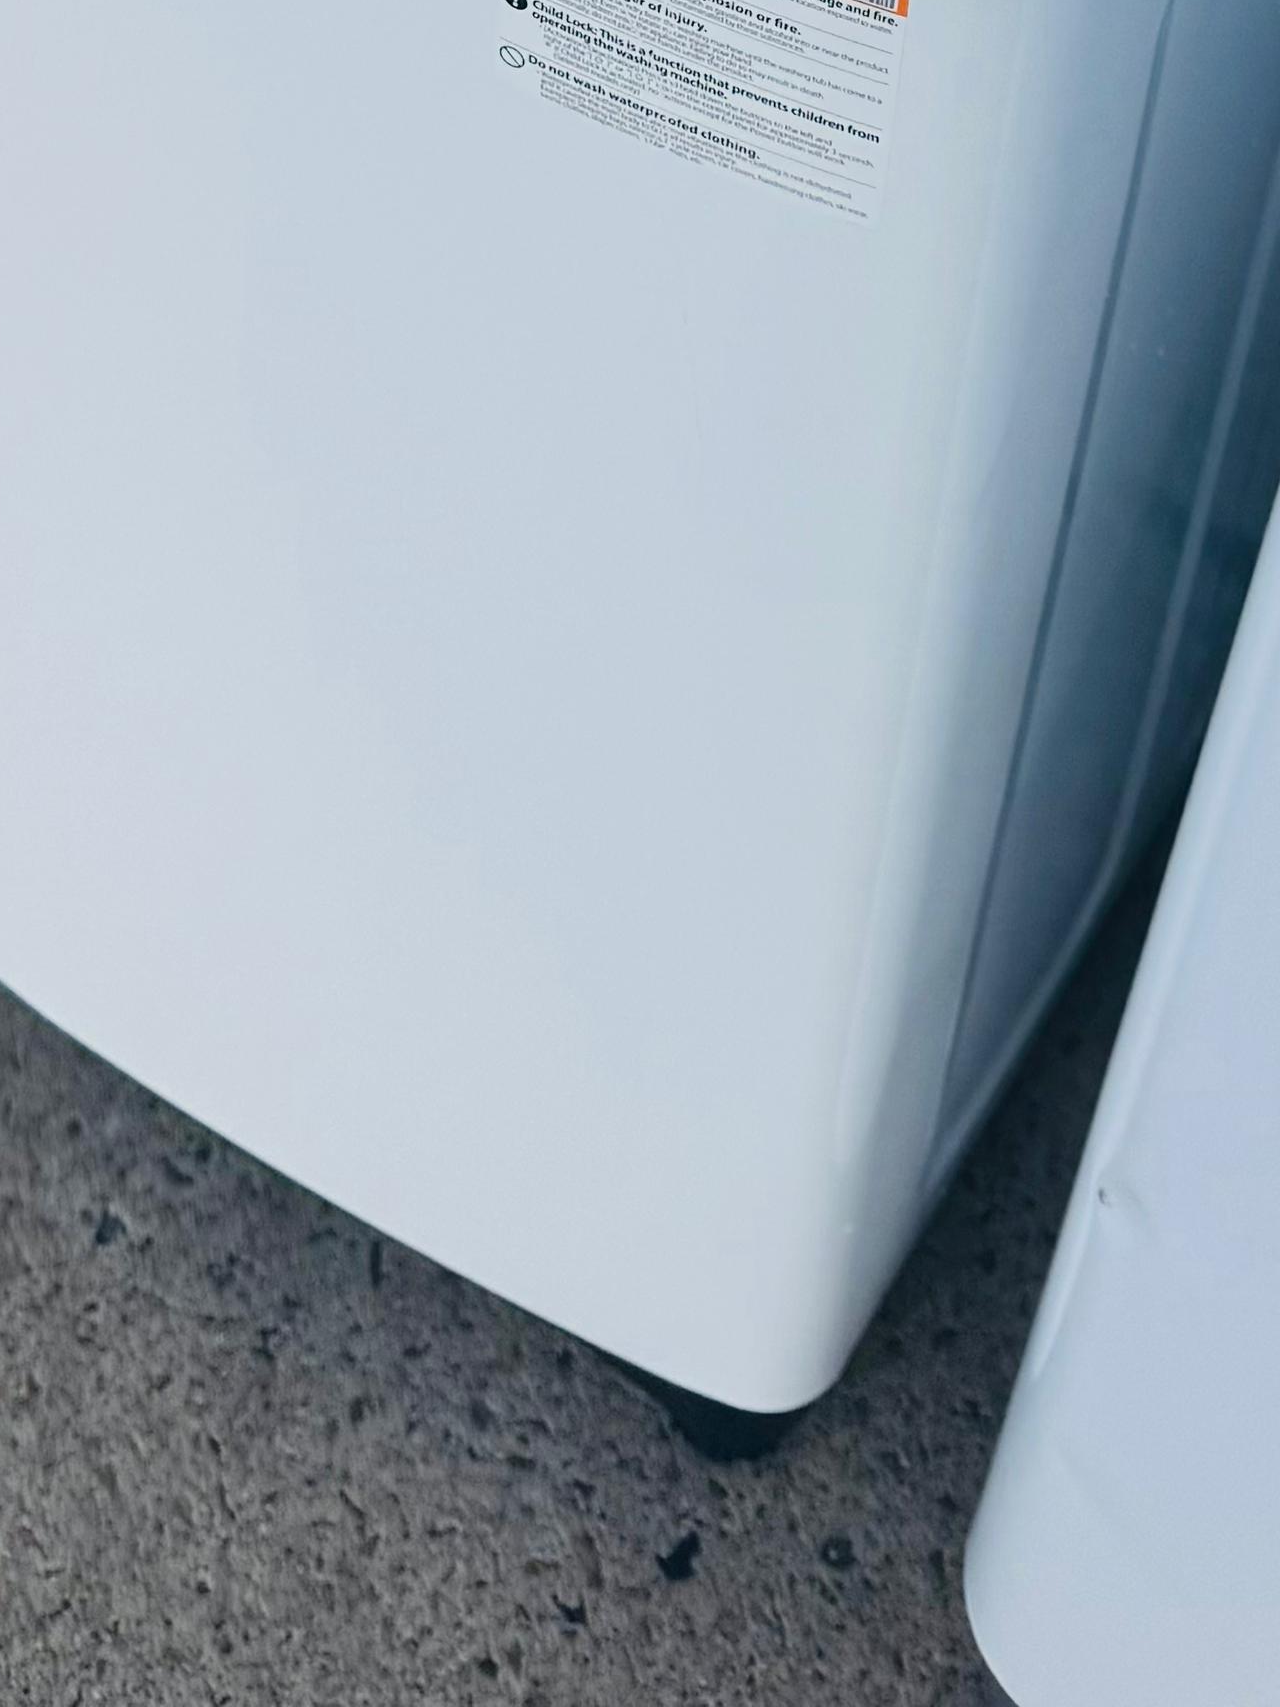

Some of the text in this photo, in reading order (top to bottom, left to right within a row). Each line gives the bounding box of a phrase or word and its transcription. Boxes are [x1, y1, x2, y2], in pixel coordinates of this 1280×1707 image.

[647, 0, 662, 14] of
[664, 6, 708, 36] injury.
[756, 12, 771, 24] or
[774, 16, 802, 35] fire.
[845, 0, 871, 17] and
[872, 9, 899, 27] fire.
[531, 8, 591, 45] operating
[593, 34, 614, 52] the
[669, 67, 728, 100] machine.
[566, 14, 598, 35] Lock:
[598, 27, 625, 47] This
[626, 39, 636, 52] is
[637, 46, 646, 56] a
[647, 48, 701, 79] function
[703, 71, 730, 91] that
[731, 84, 789, 115] prevents
[790, 104, 845, 132] children
[847, 124, 880, 143] from
[527, 53, 546, 70] Do
[548, 63, 570, 81] not
[573, 73, 606, 96] wash
[700, 127, 761, 162] clothing.
